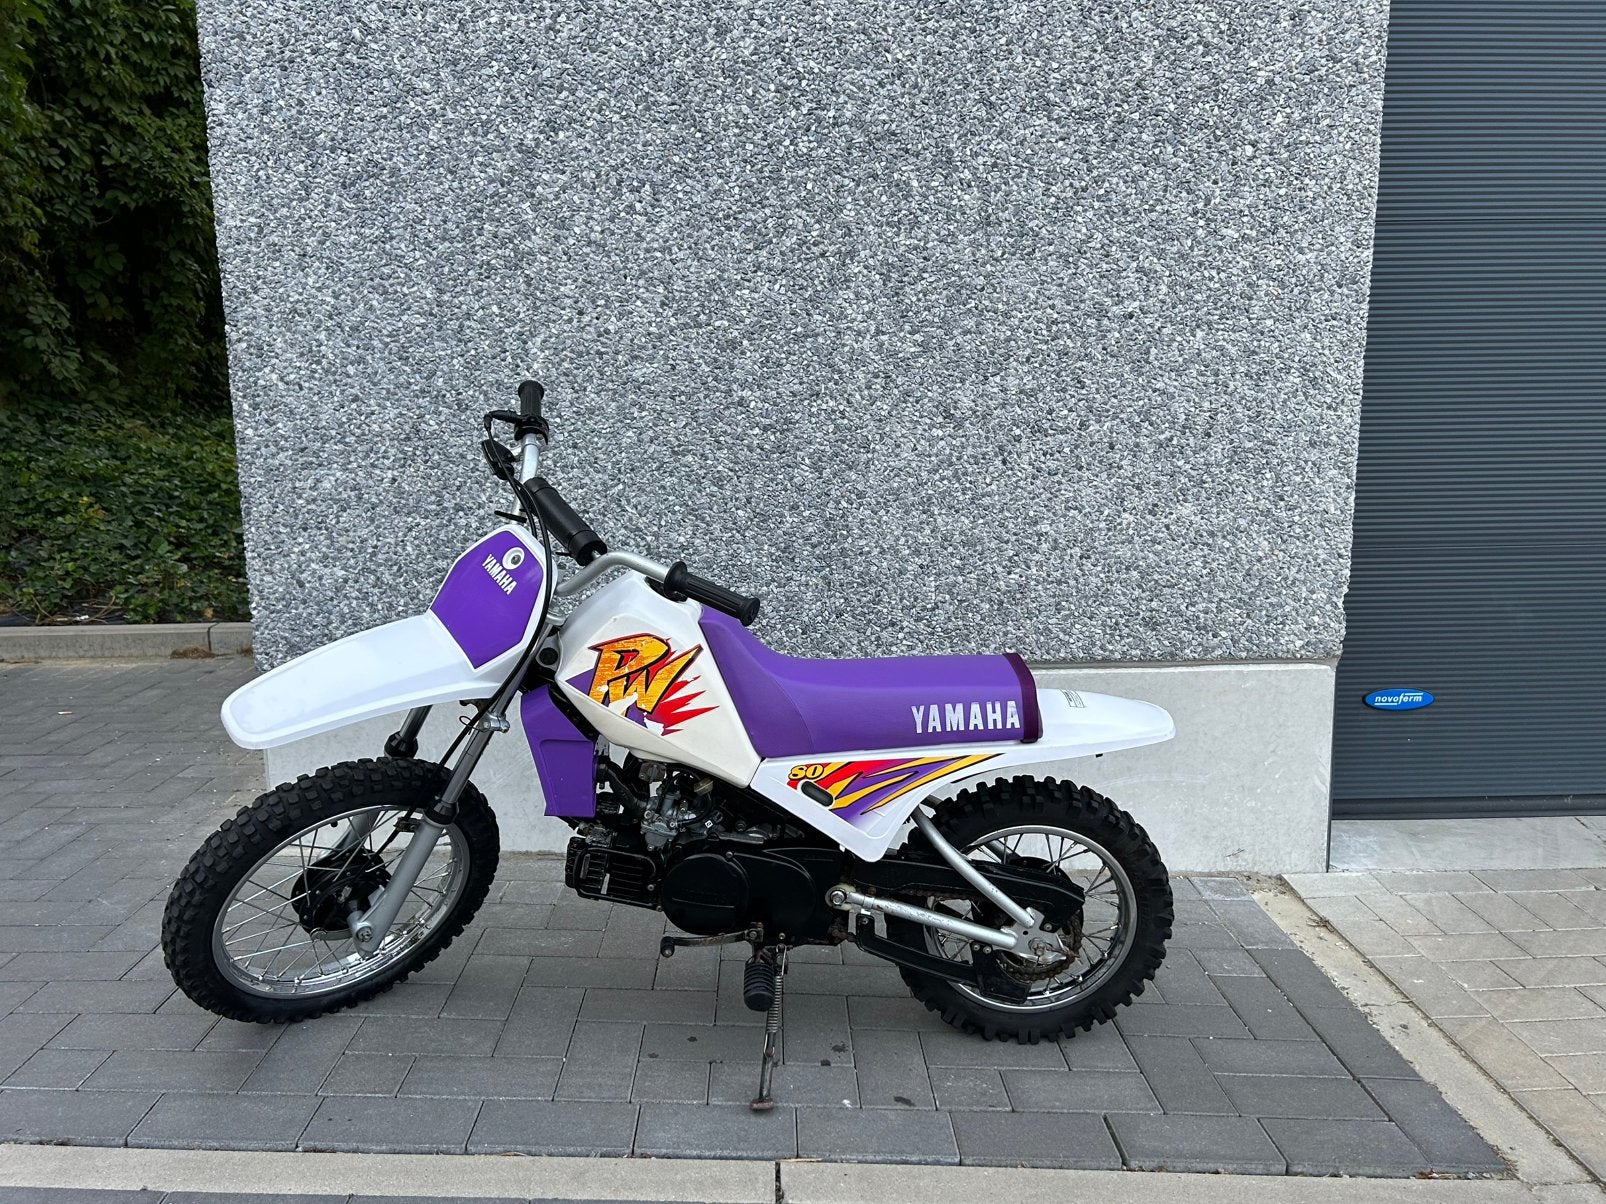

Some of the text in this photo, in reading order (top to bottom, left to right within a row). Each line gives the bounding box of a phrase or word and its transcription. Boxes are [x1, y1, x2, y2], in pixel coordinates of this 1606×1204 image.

[482, 554, 517, 595] YAMAHA
[588, 633, 703, 717] PW
[1374, 692, 1423, 705] novoferm
[911, 700, 1020, 734] YAMAHA
[788, 764, 824, 780] 80
